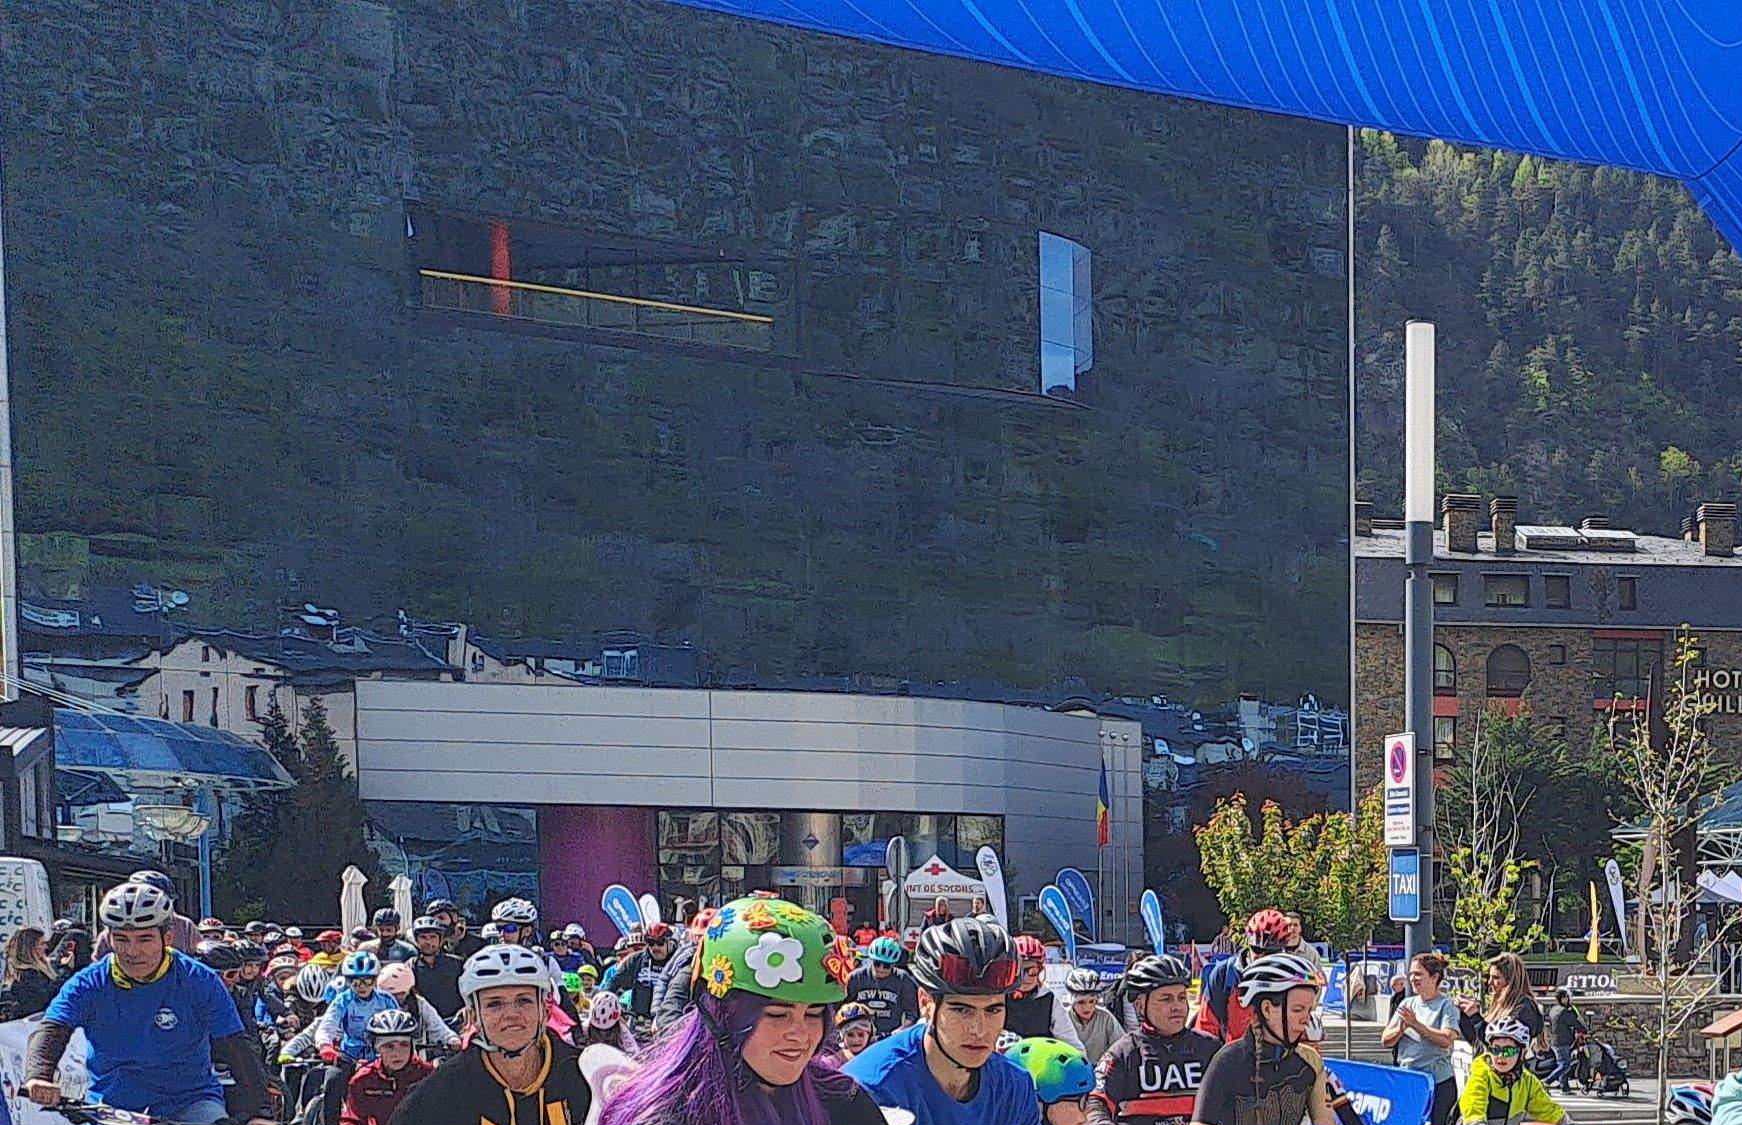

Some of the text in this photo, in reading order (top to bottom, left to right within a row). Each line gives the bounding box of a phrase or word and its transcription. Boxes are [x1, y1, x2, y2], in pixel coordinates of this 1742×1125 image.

[1392, 874, 1416, 895] TAXI
[857, 988, 898, 1004] NEW YORK
[1138, 1062, 1201, 1092] UAE
